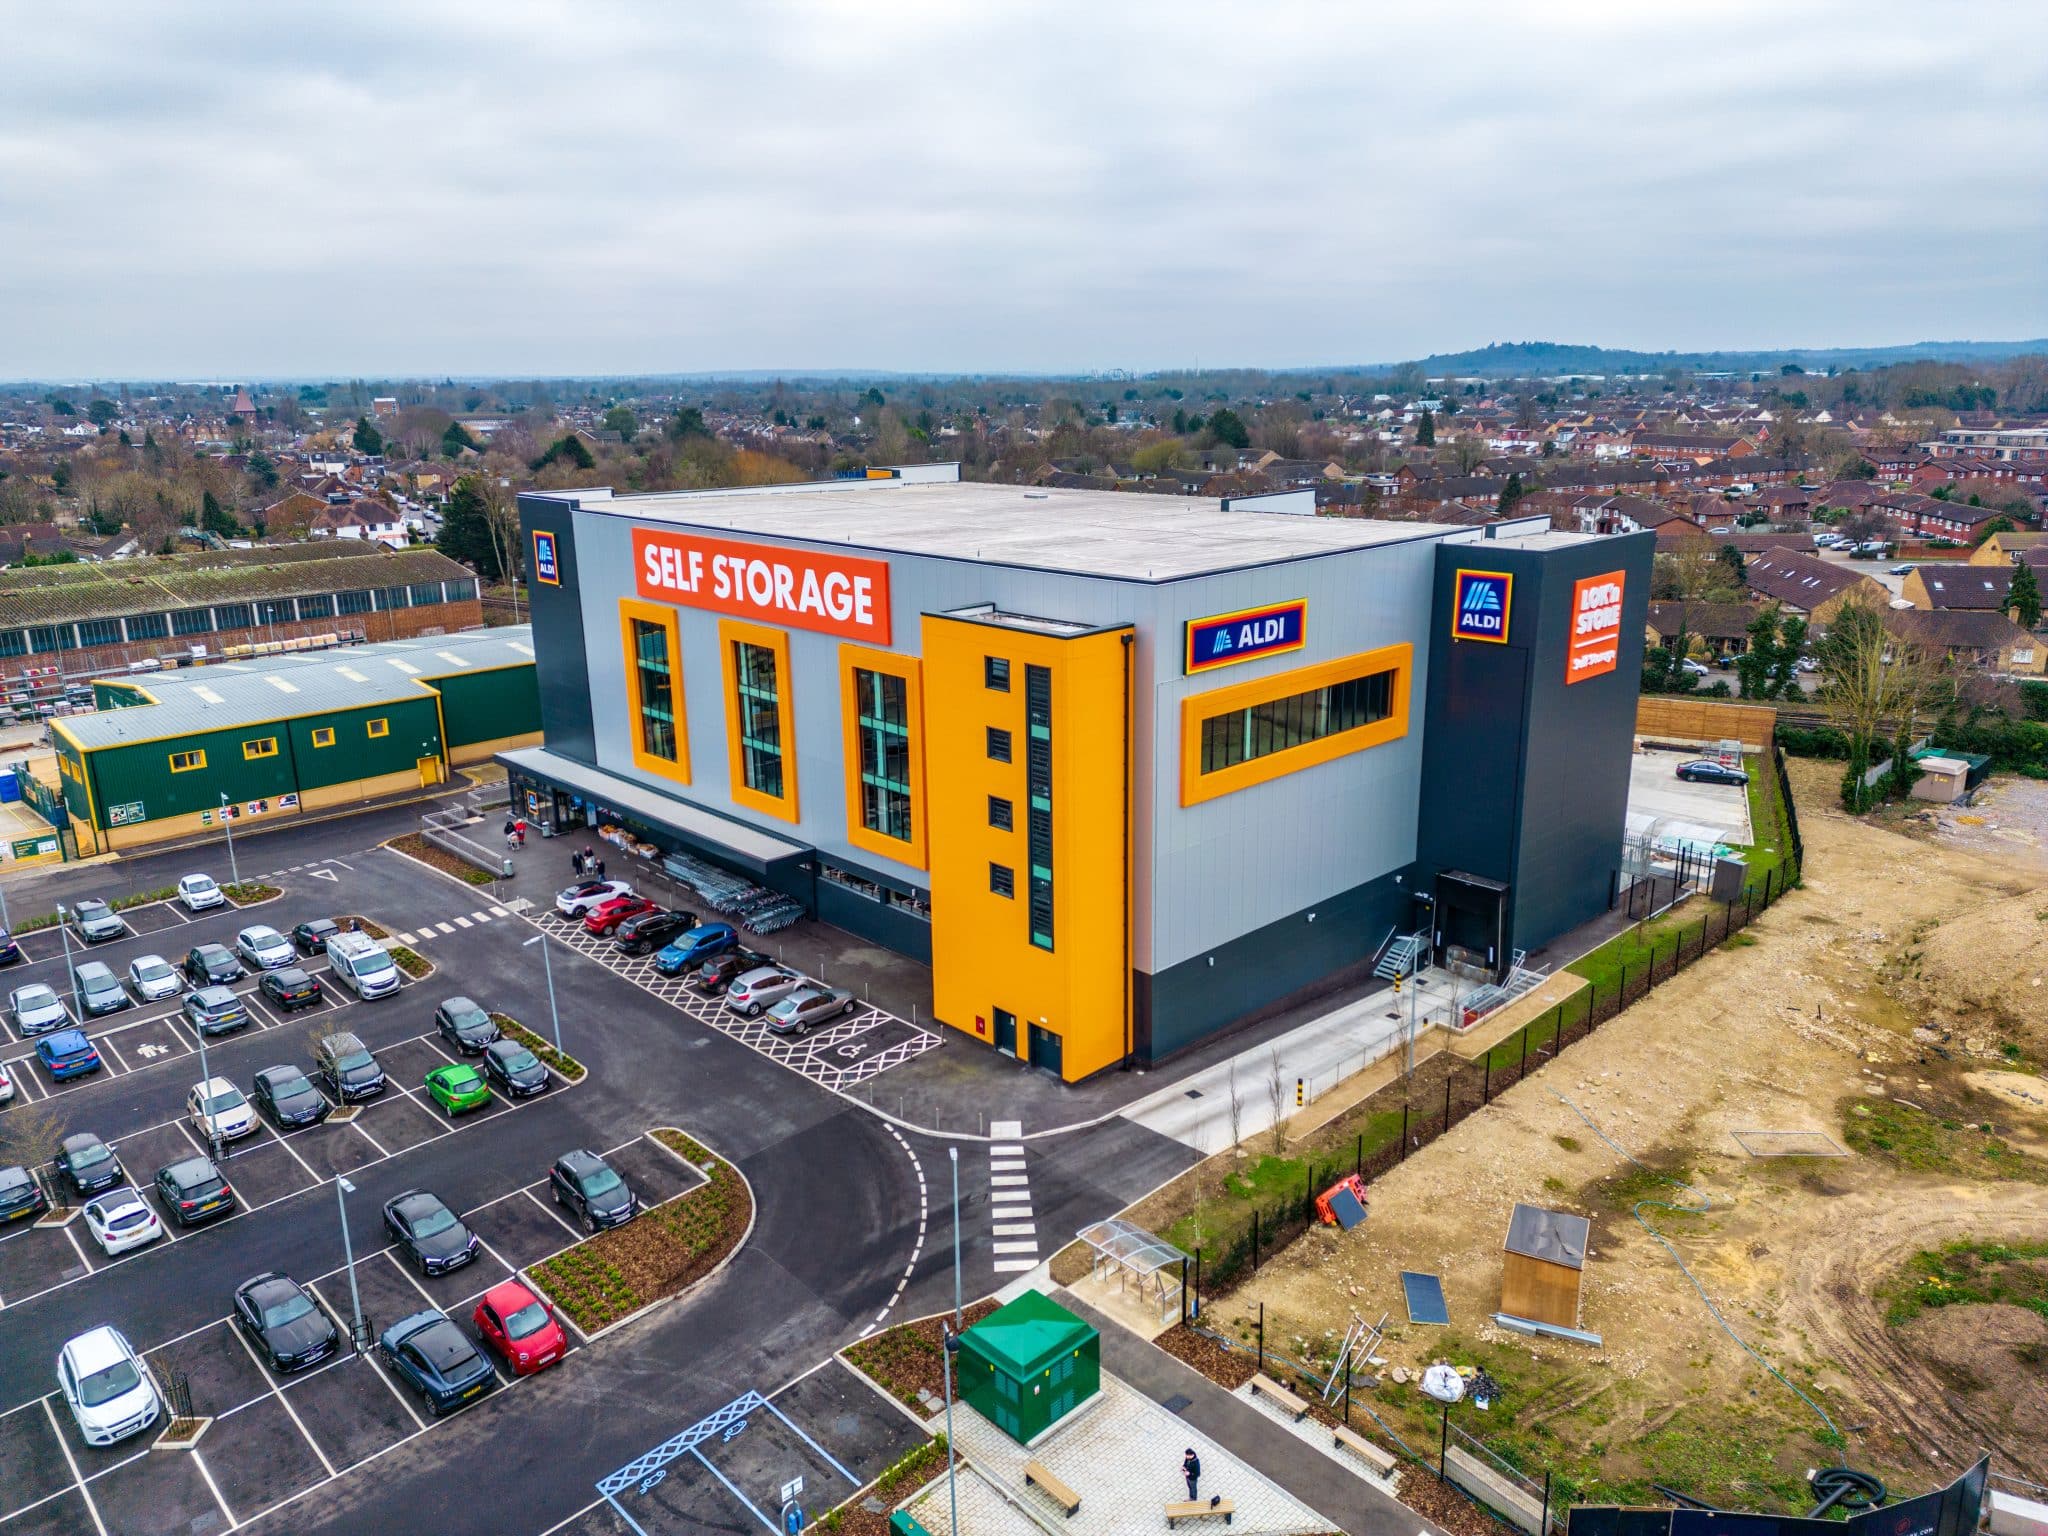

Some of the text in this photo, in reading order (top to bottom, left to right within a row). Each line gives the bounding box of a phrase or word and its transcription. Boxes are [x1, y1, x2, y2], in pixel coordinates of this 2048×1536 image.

[540, 563, 555, 575] ALDI
[644, 543, 874, 626] SELF STORAGE
[1238, 617, 1285, 648] ALDI
[1461, 613, 1501, 629] ALDI
[1576, 605, 1621, 634] STORE
